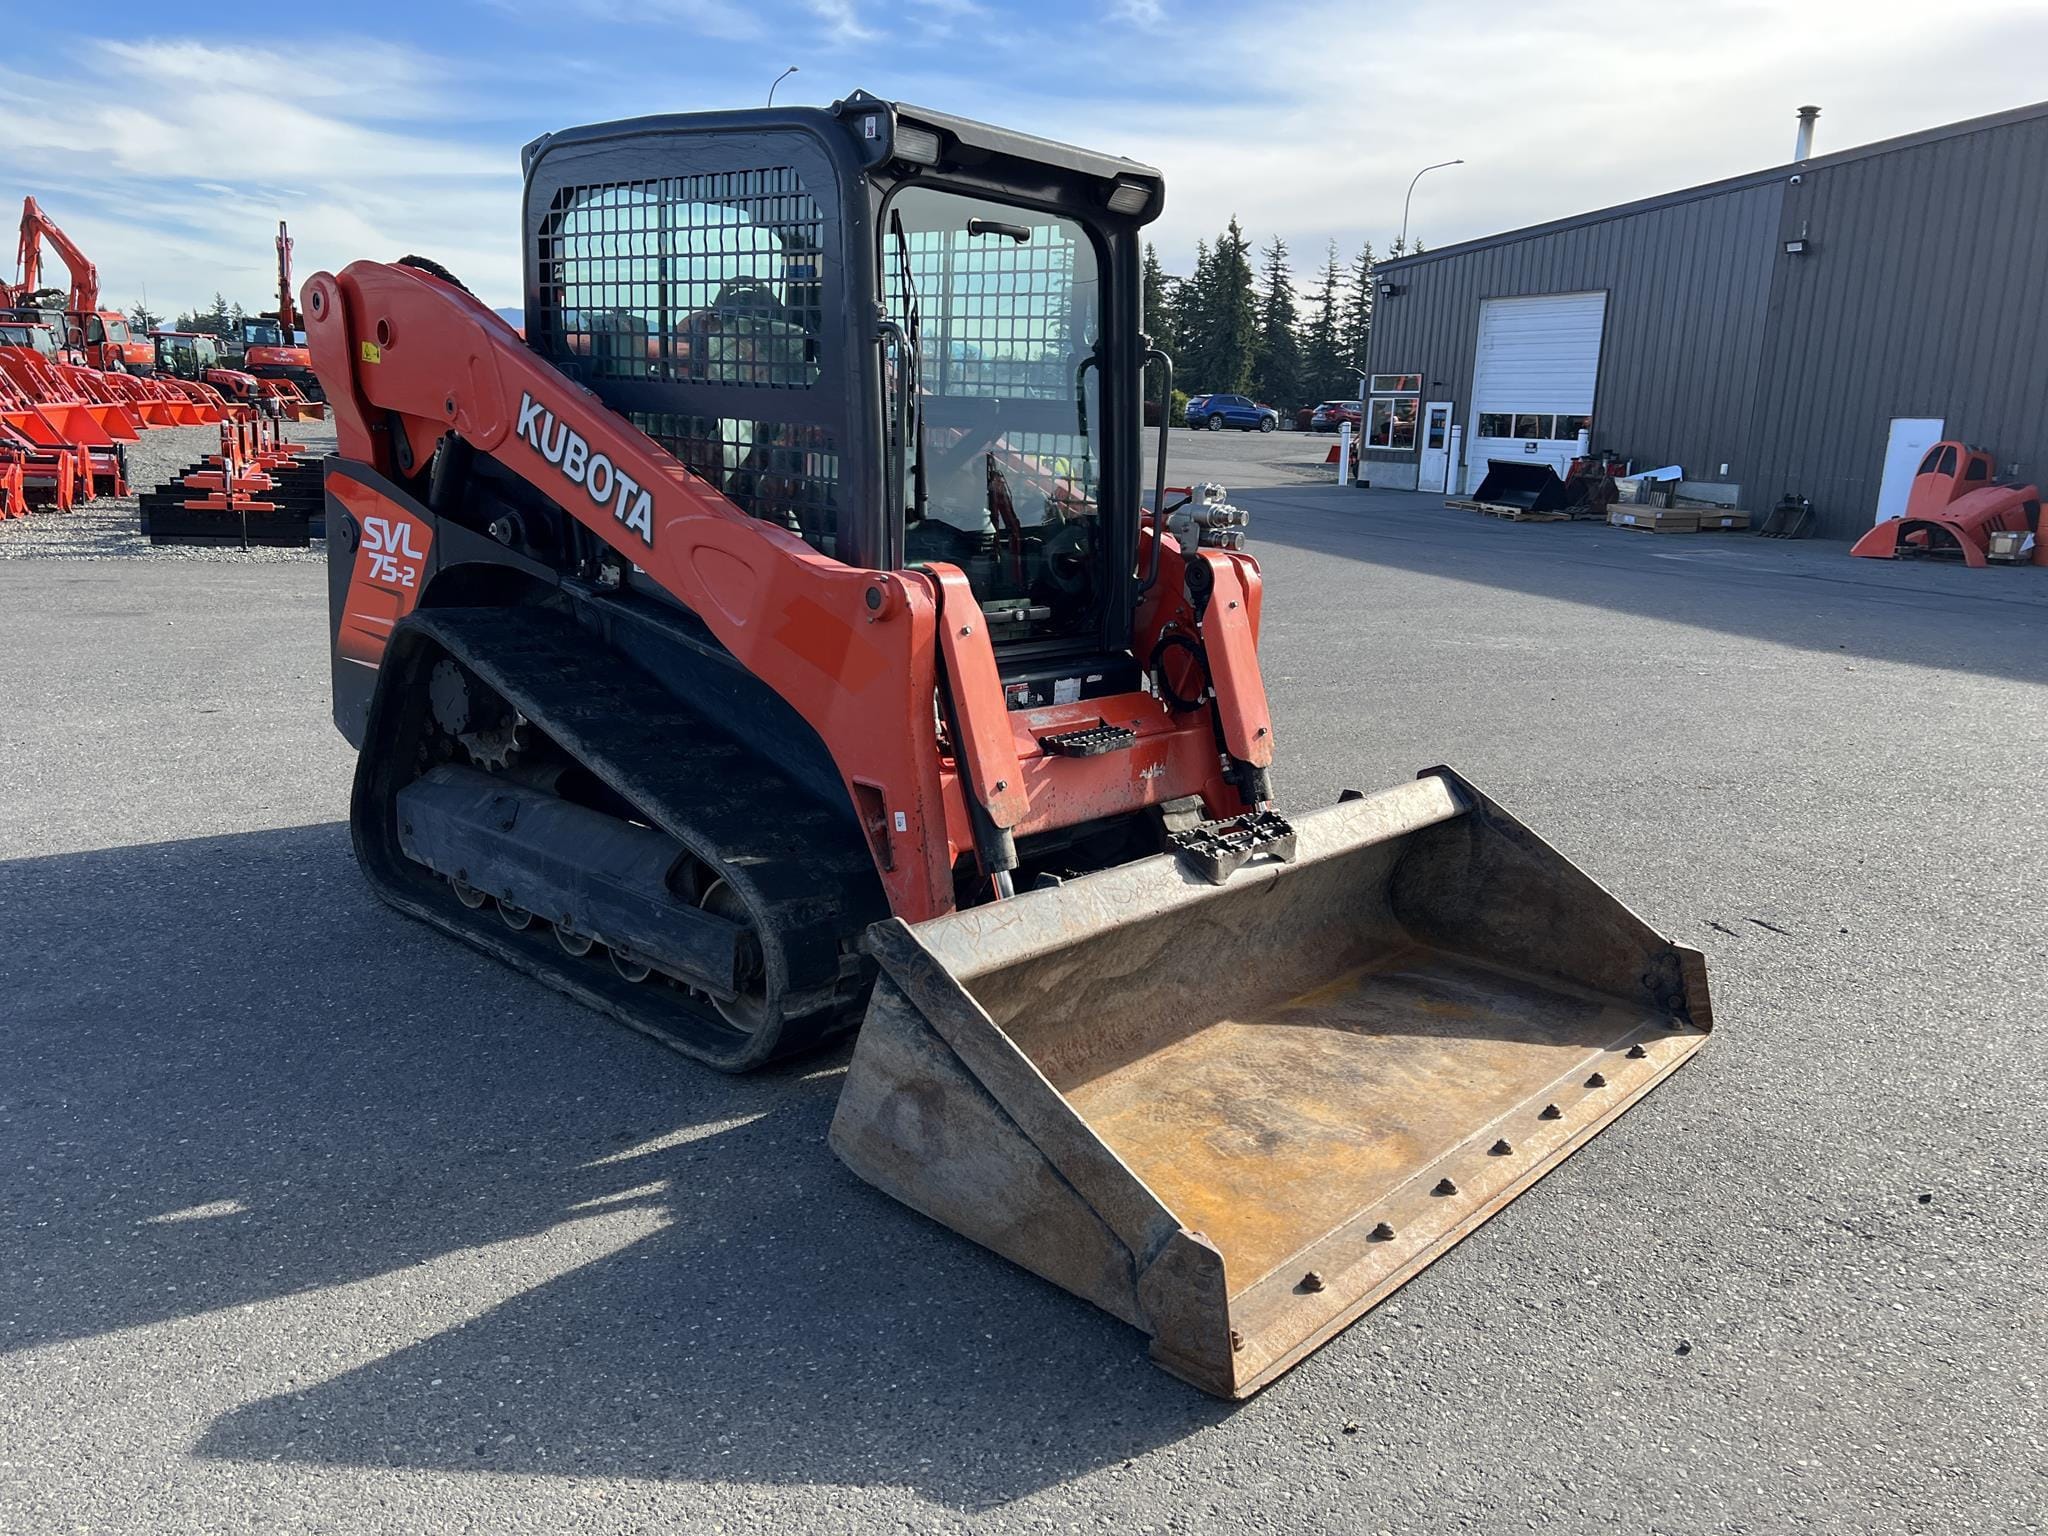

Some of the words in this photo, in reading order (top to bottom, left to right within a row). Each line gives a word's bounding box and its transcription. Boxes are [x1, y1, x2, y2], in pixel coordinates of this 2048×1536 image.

[516, 391, 652, 545] KUBOTA
[362, 516, 423, 560] SVL
[368, 551, 416, 588] 75-2
